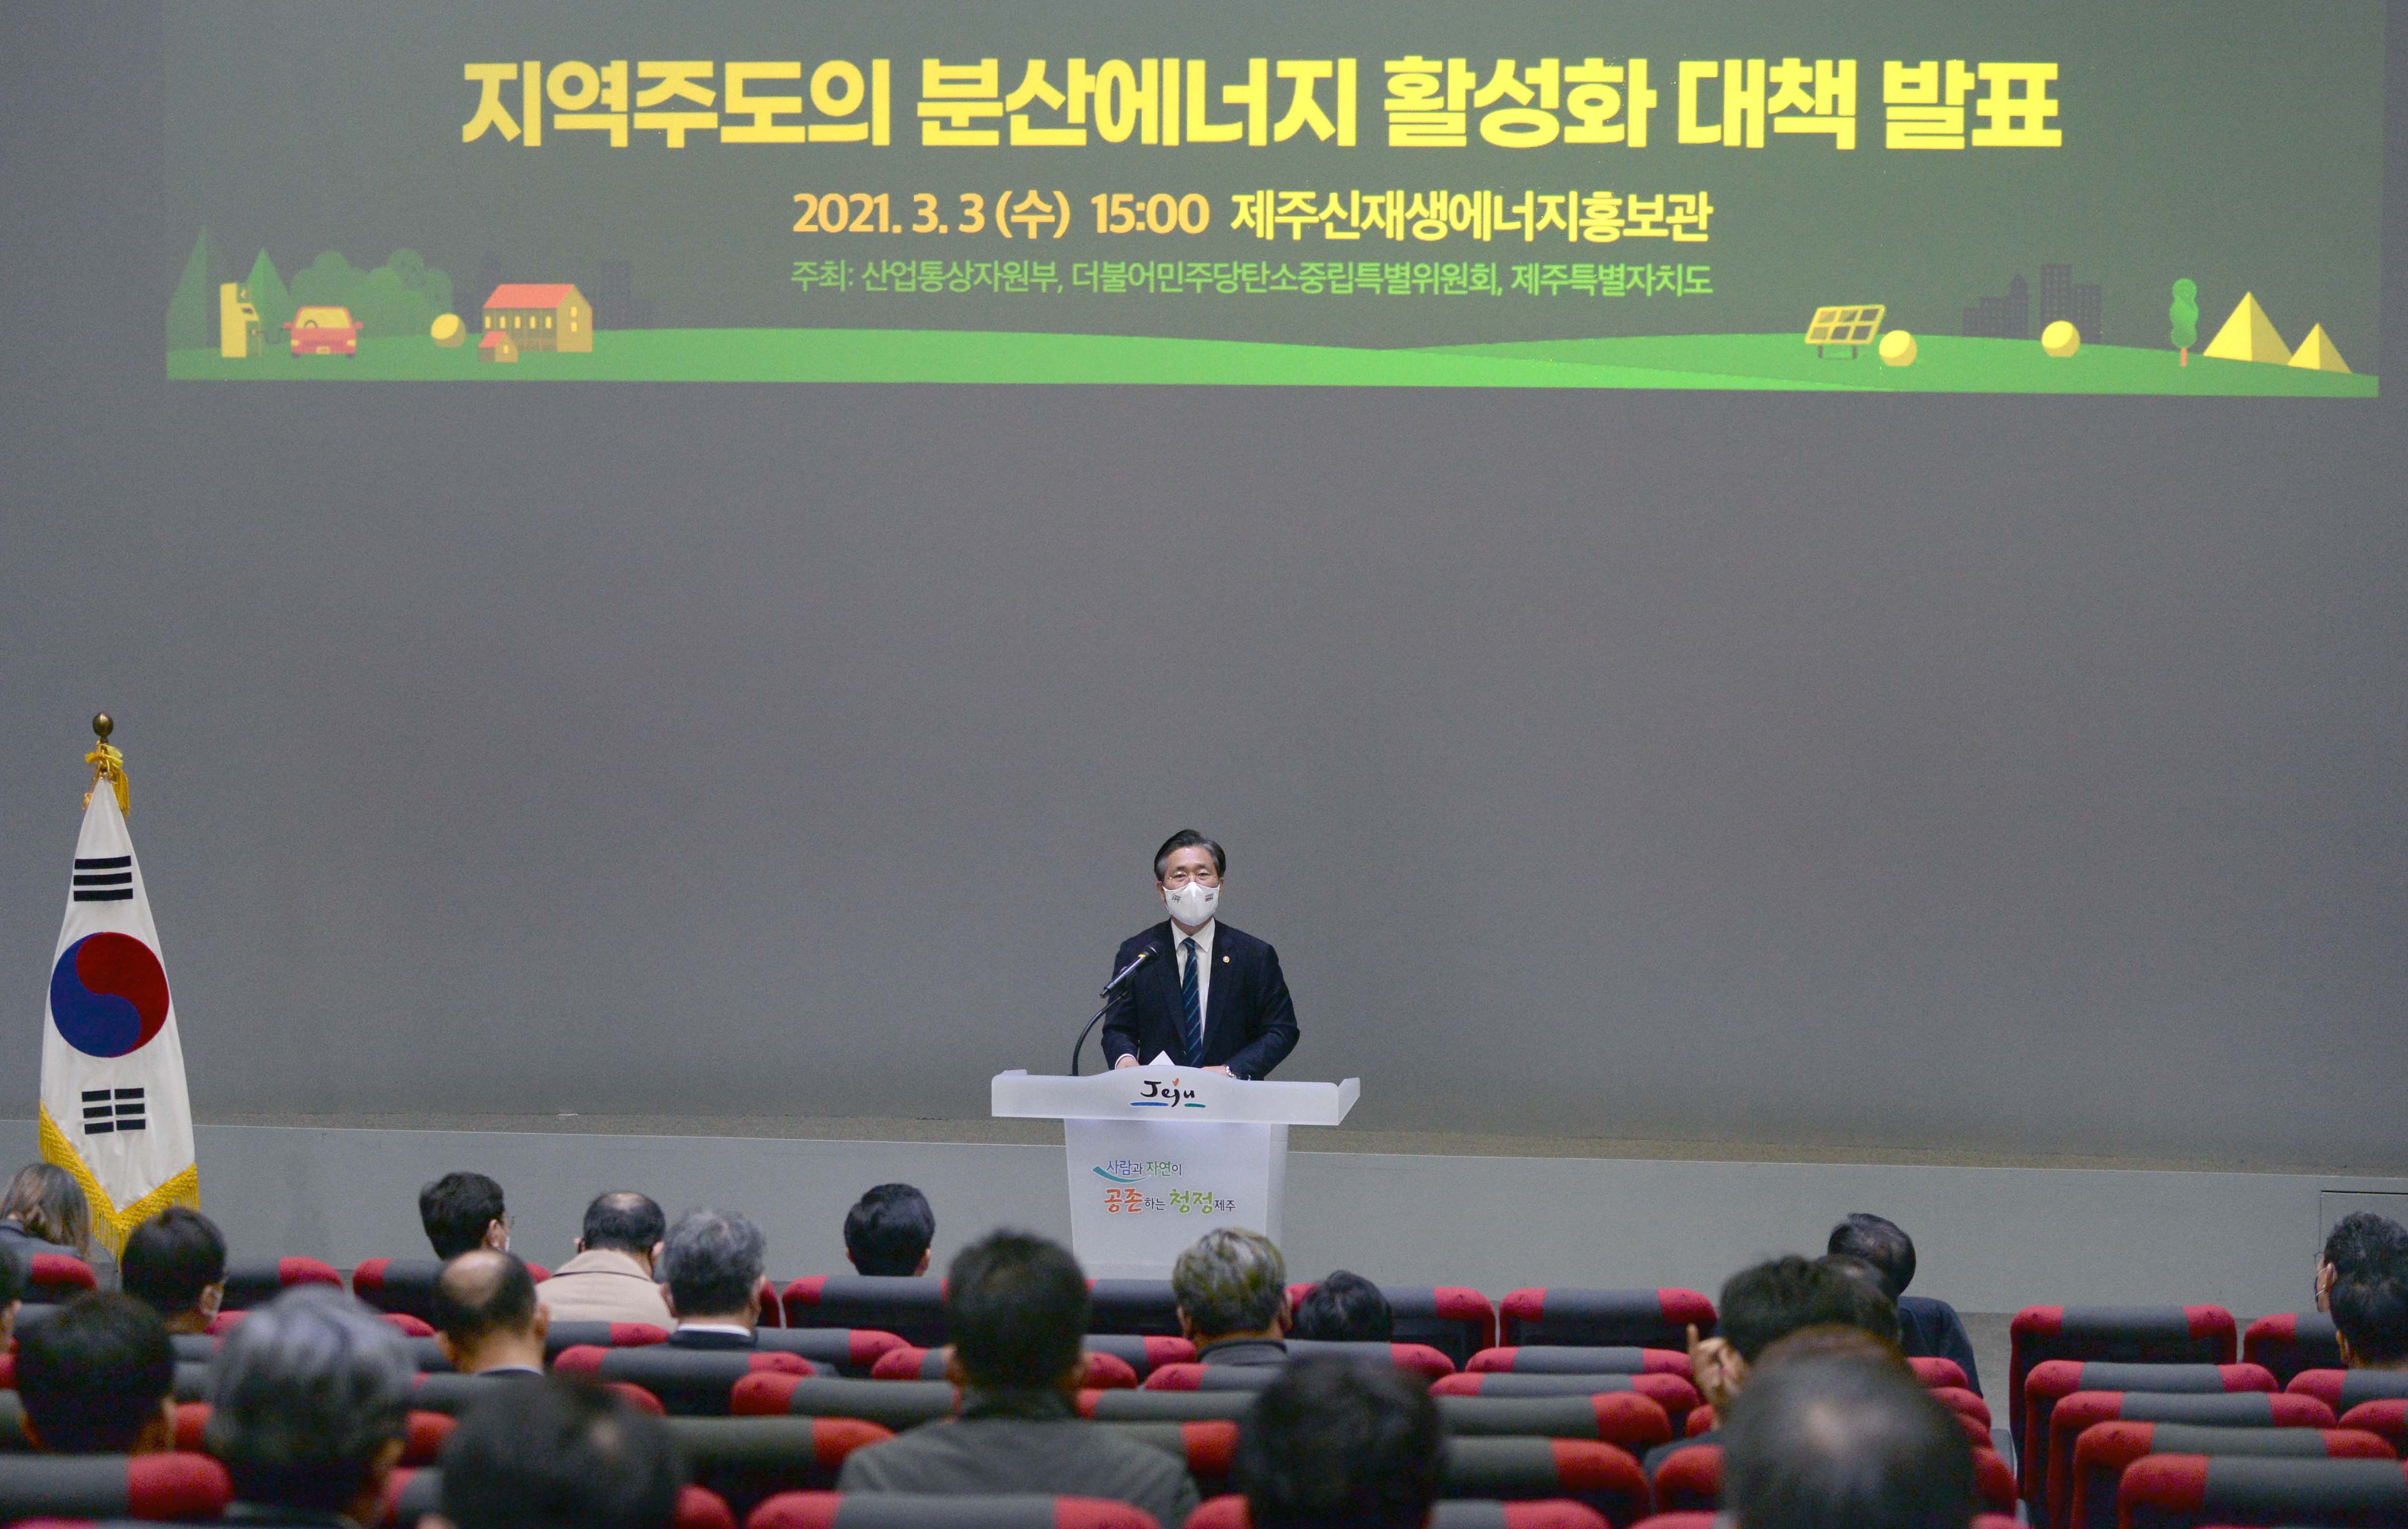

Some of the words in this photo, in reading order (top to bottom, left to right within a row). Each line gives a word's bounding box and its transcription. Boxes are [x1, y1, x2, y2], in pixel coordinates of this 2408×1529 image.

[463, 58, 891, 148] 지역주도의
[917, 57, 1357, 147] 분산에너지
[1384, 55, 1658, 149] 활성화
[1677, 57, 1858, 150] 대책
[1882, 59, 2063, 150] 발표
[793, 193, 902, 234] 2021.
[1091, 193, 1211, 234] 15:00
[1231, 189, 1714, 244] 제주신재생에너지홍보관
[791, 260, 853, 292] 주최:
[862, 259, 1064, 294] 산업통상자원부,
[1072, 260, 1504, 298] 더불어민주당탄소중립특별위원회,
[1510, 261, 1715, 298] 제주특별자치도
[1140, 1078, 1195, 1108] Jeju
[1107, 1160, 1143, 1175] 사람과
[1146, 1161, 1182, 1176] 자연이
[1104, 1188, 1165, 1213] 공존하는
[1169, 1188, 1236, 1214] 청정제주
